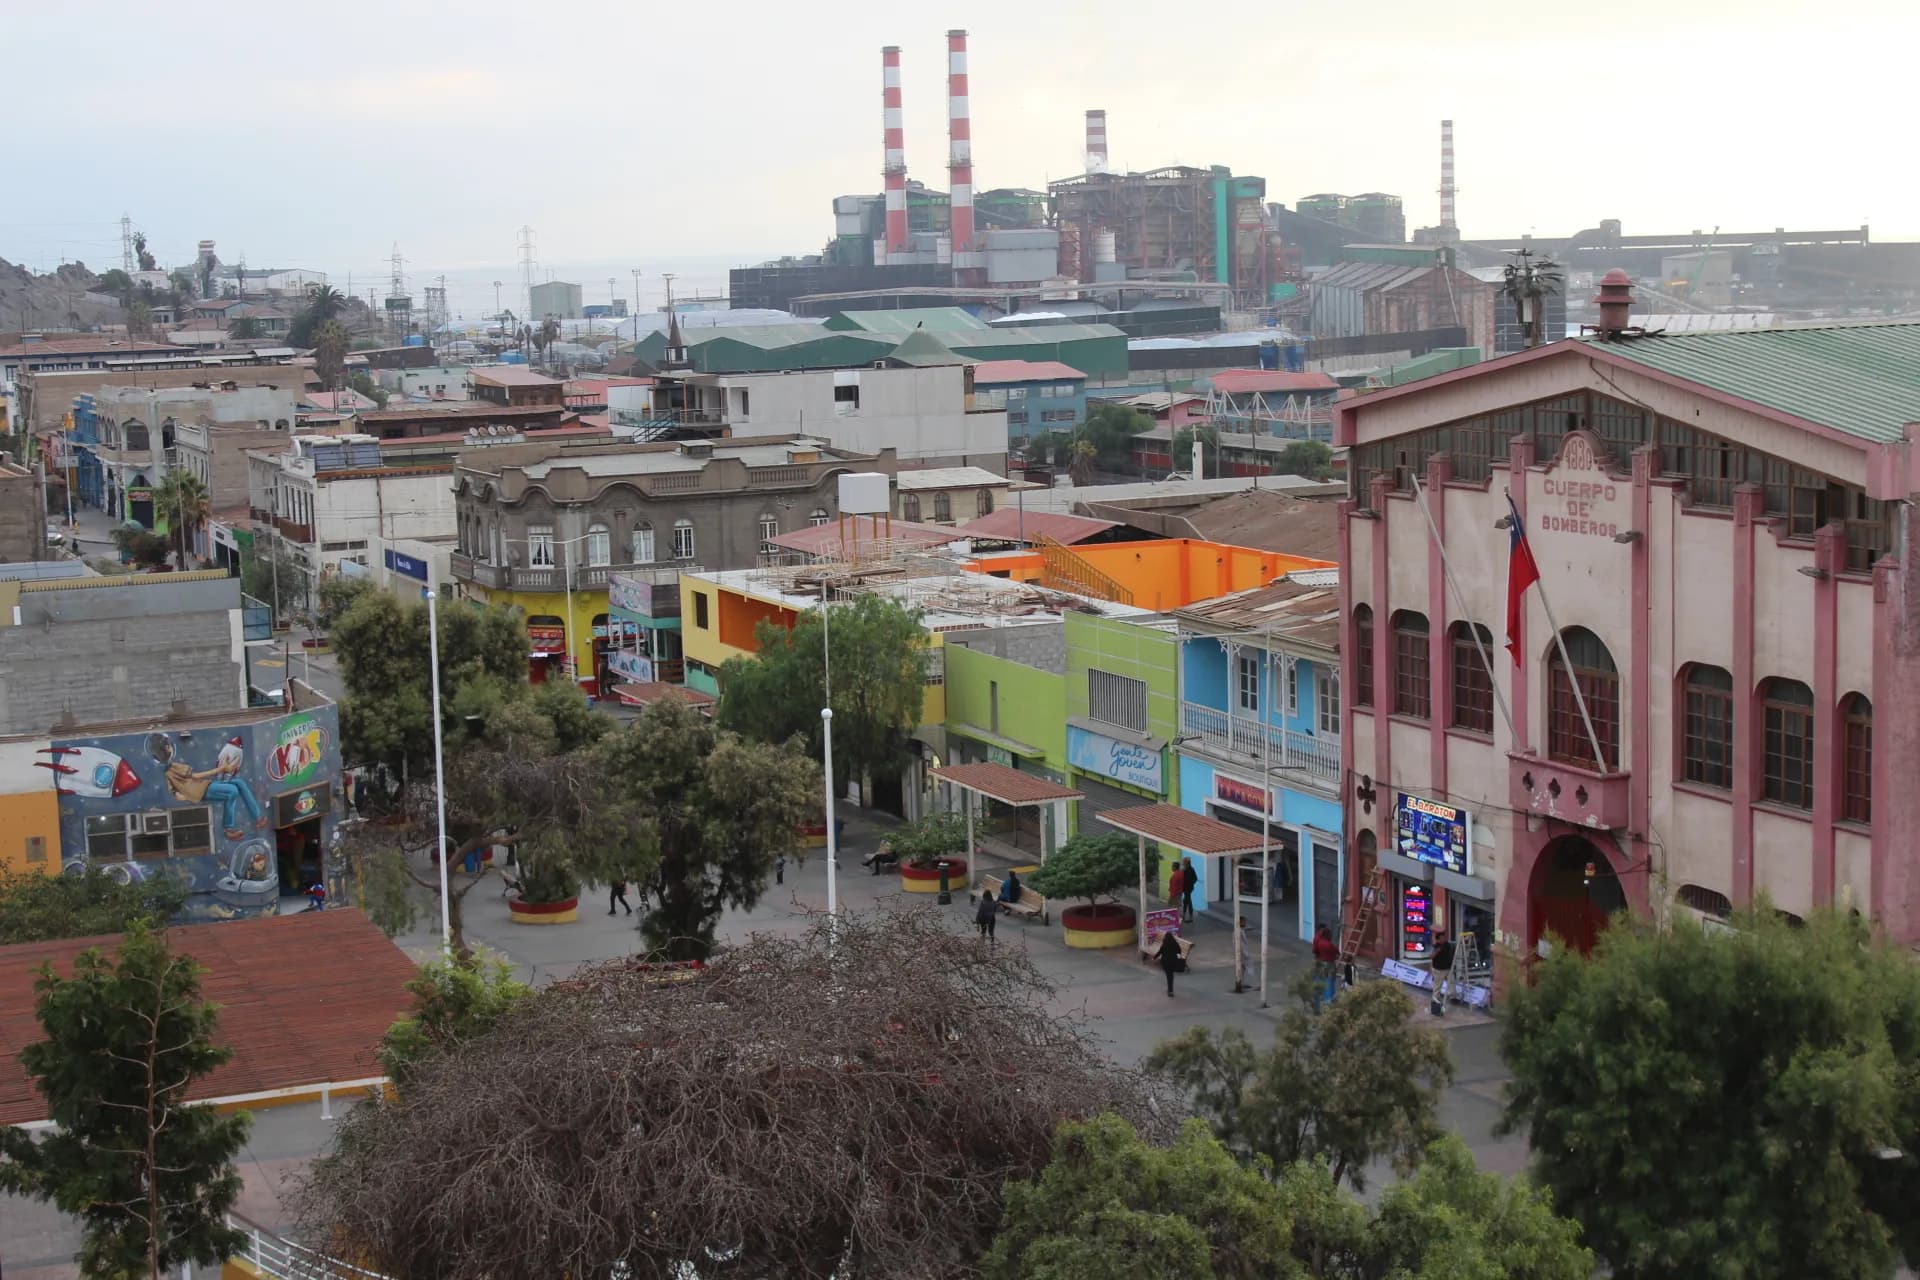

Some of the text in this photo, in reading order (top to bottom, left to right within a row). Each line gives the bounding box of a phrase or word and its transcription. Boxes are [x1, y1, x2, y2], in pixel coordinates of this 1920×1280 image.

[1543, 479, 1616, 502] CUERPO
[1566, 500, 1589, 518] DE
[1541, 515, 1617, 539] BOMBEROS
[275, 729, 321, 778] KIDS
[1110, 741, 1148, 760] Gente
[1407, 796, 1457, 822] EL BARATON
